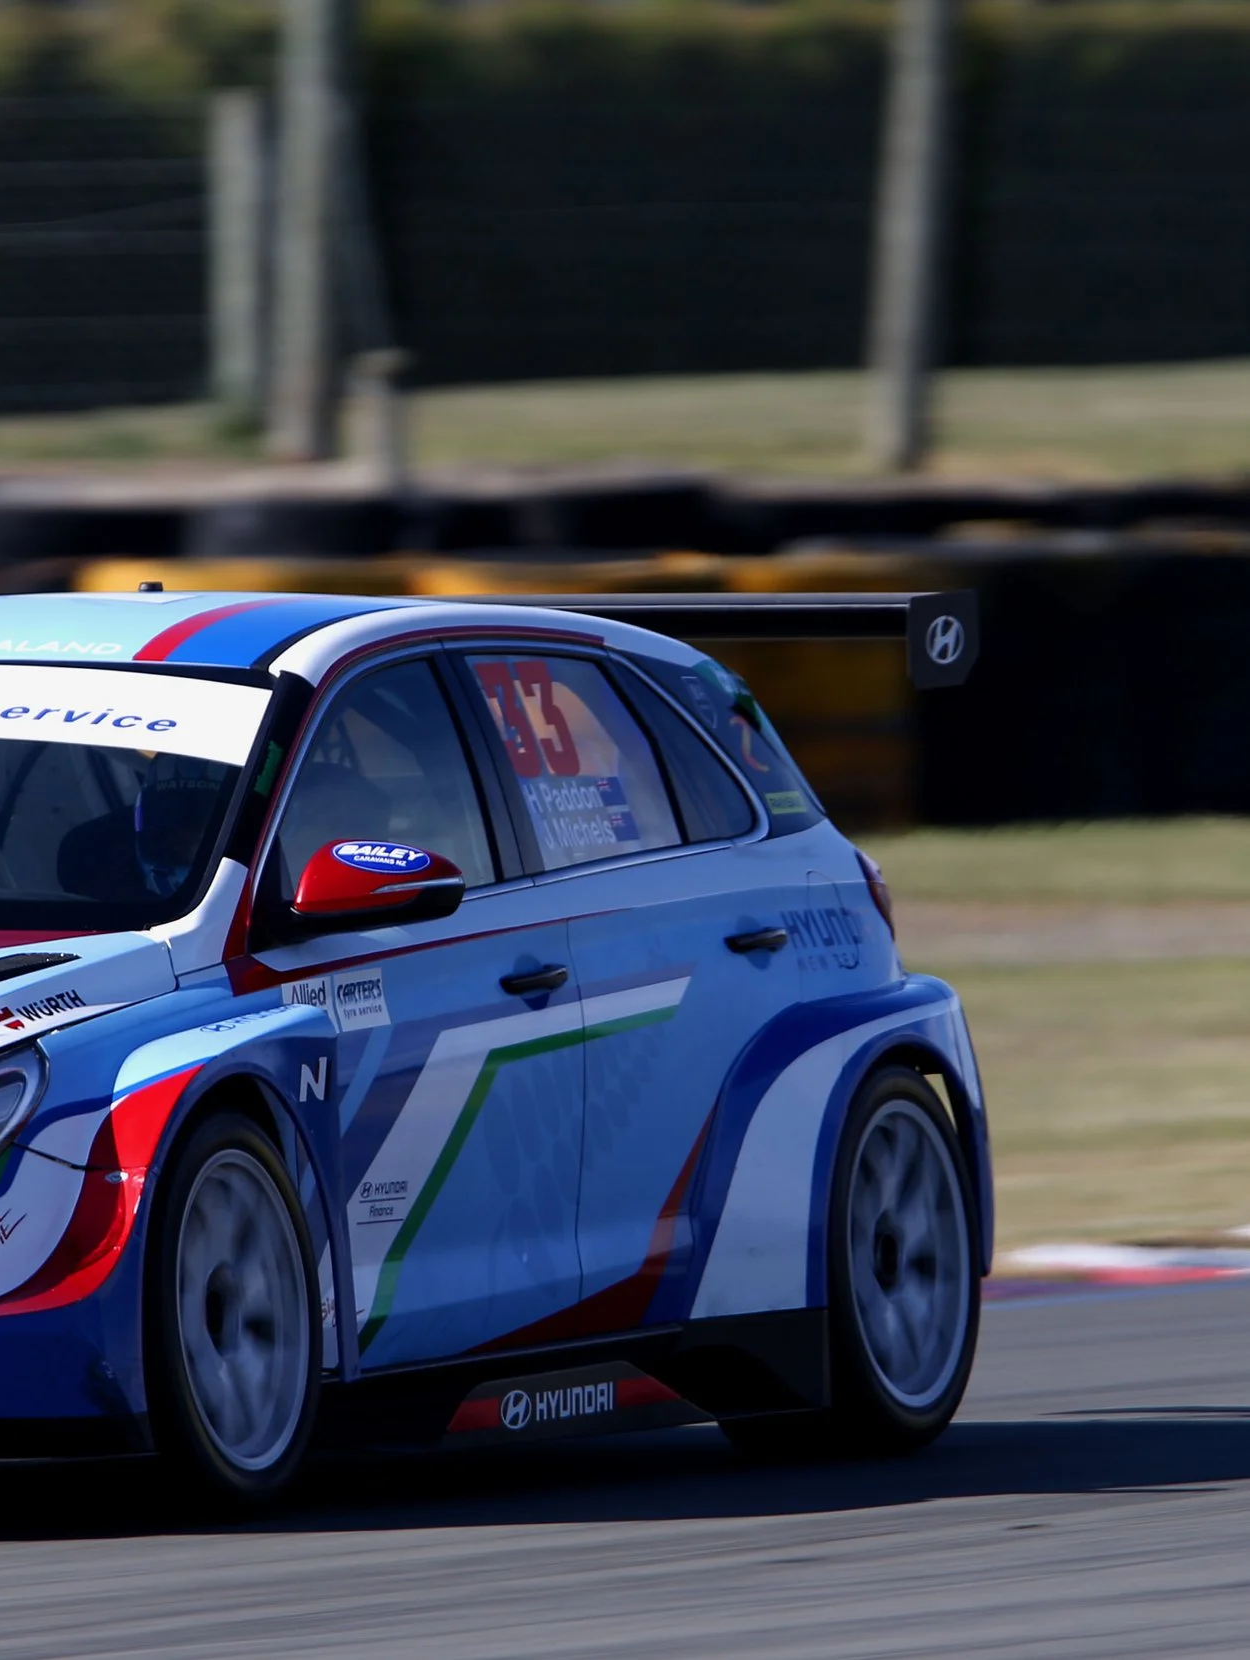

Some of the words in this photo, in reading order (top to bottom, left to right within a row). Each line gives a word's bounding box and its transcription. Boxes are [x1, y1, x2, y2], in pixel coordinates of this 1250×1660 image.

[474, 660, 581, 777] 33
[523, 783, 544, 813] H
[540, 779, 604, 813] Paddon
[557, 815, 617, 848] Michels
[337, 844, 425, 861] BAILEY
[353, 855, 395, 865] CARAVANS
[395, 859, 407, 867] NZ
[777, 907, 864, 949] HYUND
[291, 980, 327, 1007] Allied
[336, 978, 383, 1005] CARTER'S
[299, 1056, 328, 1103] N
[374, 1181, 408, 1196] HYUNDAI
[535, 1381, 613, 1422] HYUNDAI
